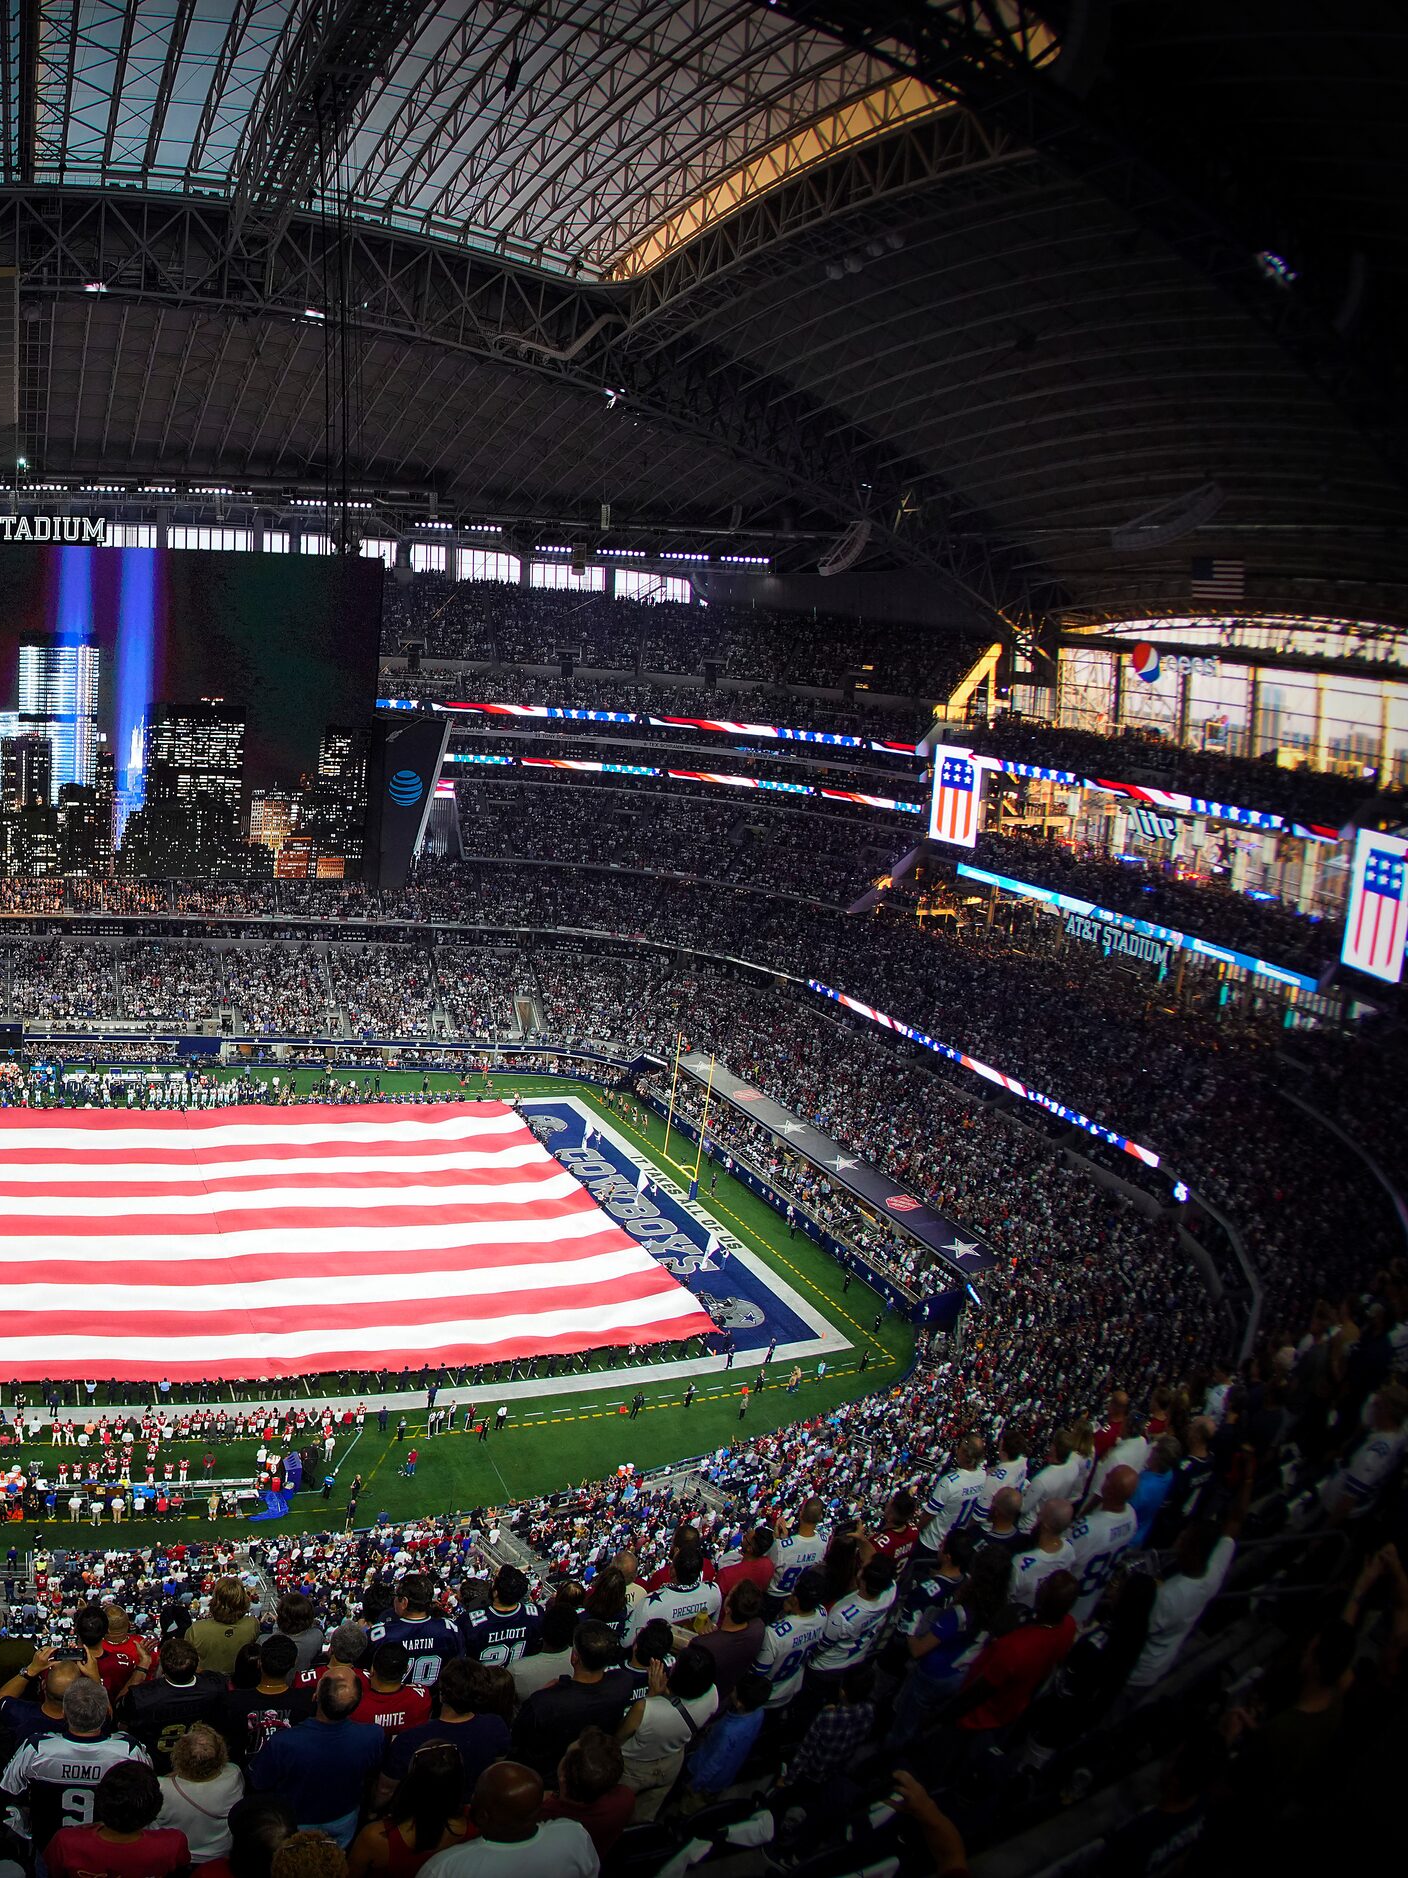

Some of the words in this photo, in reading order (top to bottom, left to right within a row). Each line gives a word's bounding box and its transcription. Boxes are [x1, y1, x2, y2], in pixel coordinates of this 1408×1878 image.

[1128, 805, 1176, 842] Lite
[1065, 914, 1102, 944] AT&T
[1102, 925, 1169, 968] STADIUM
[555, 1147, 721, 1275] COWBOYS
[630, 1155, 648, 1165] IT
[644, 1165, 684, 1196] TAKES
[678, 1199, 700, 1217] ALL
[701, 1219, 725, 1233] OF
[719, 1235, 743, 1251] US
[873, 1532, 891, 1549] 12
[796, 1552, 817, 1564] LAMB
[1021, 1556, 1037, 1572] 4
[672, 1601, 708, 1619] PRESCOTT
[841, 1604, 860, 1622] 11
[488, 1626, 527, 1644] ELLIOTT
[793, 1628, 822, 1649] BRYANT
[402, 1638, 434, 1651] MARTIN
[374, 1711, 406, 1726] WHITE
[61, 1763, 102, 1781] ROMO
[61, 1787, 96, 1828] 9
